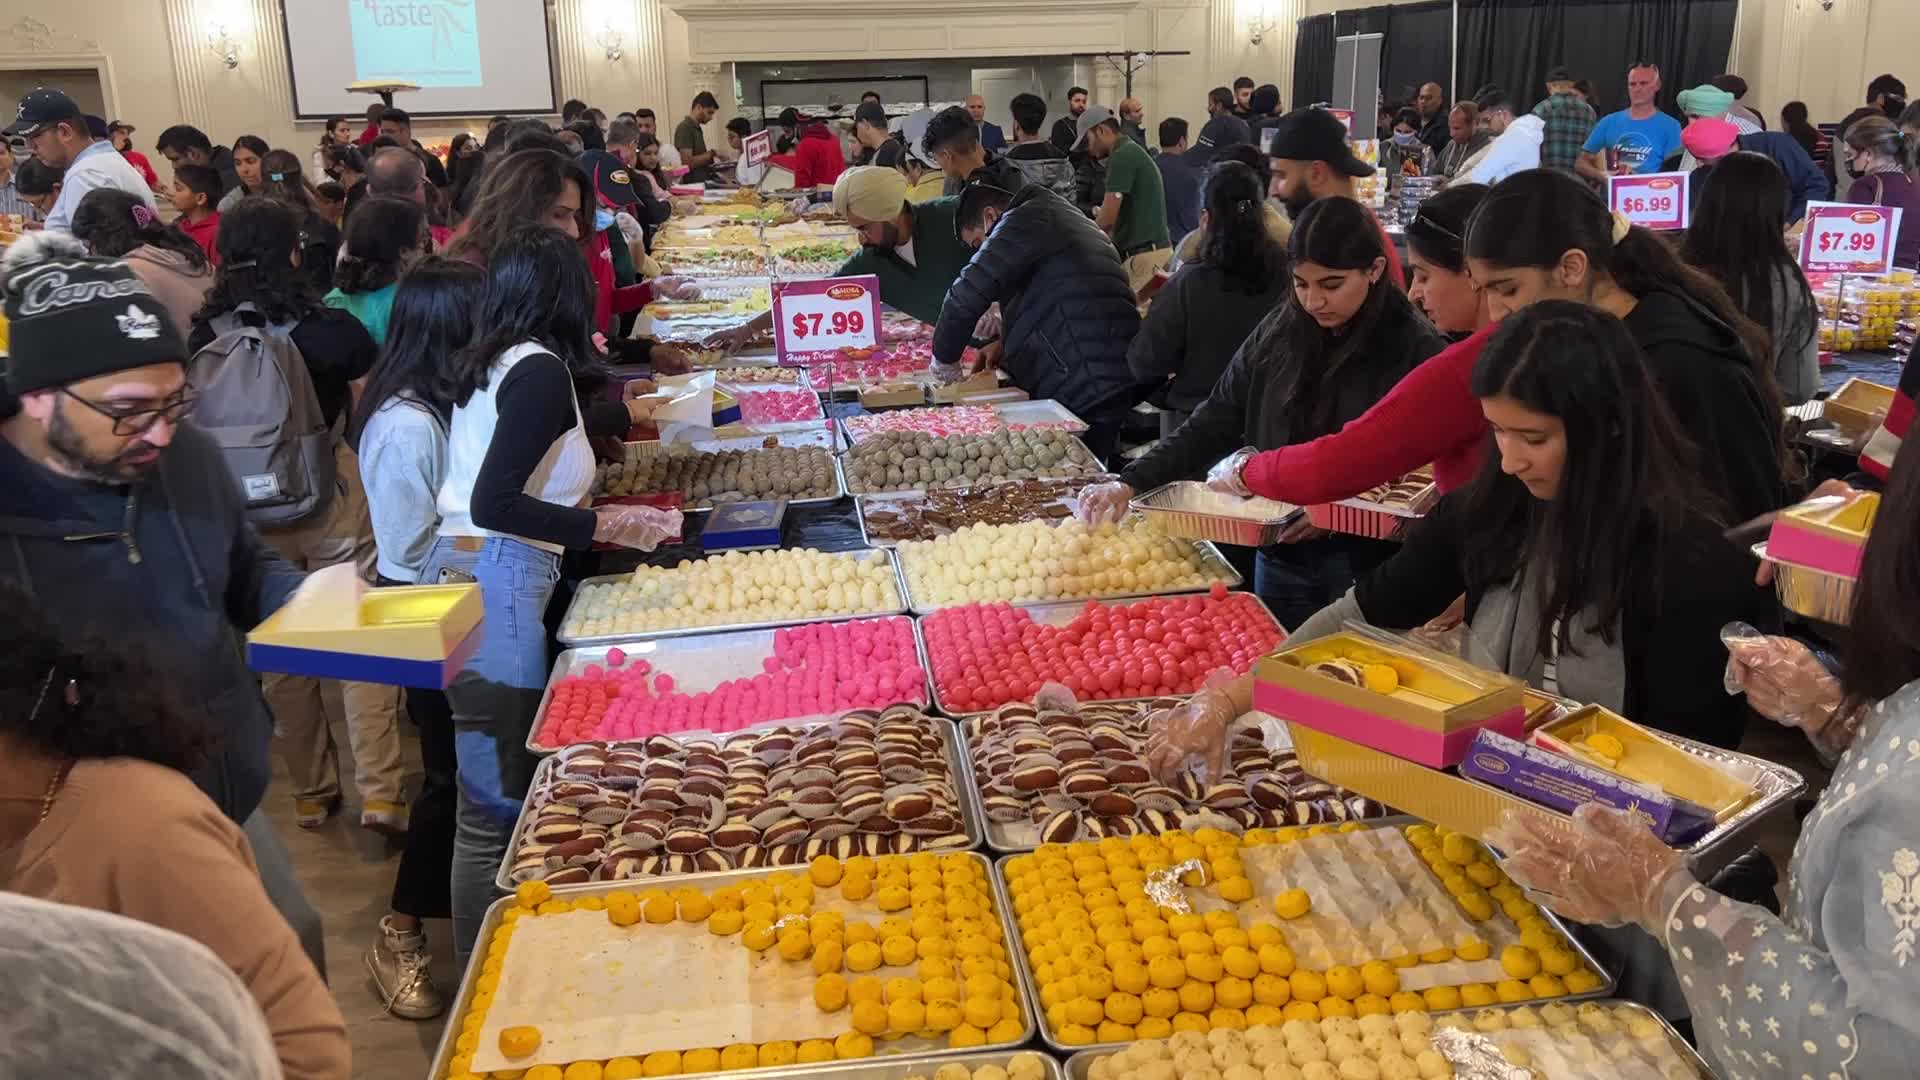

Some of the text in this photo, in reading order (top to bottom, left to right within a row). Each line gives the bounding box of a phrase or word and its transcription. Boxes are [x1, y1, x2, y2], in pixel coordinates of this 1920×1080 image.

[1623, 197, 1671, 214] $6.99
[1819, 232, 1876, 252] $7.99
[792, 311, 865, 340] $7.99
